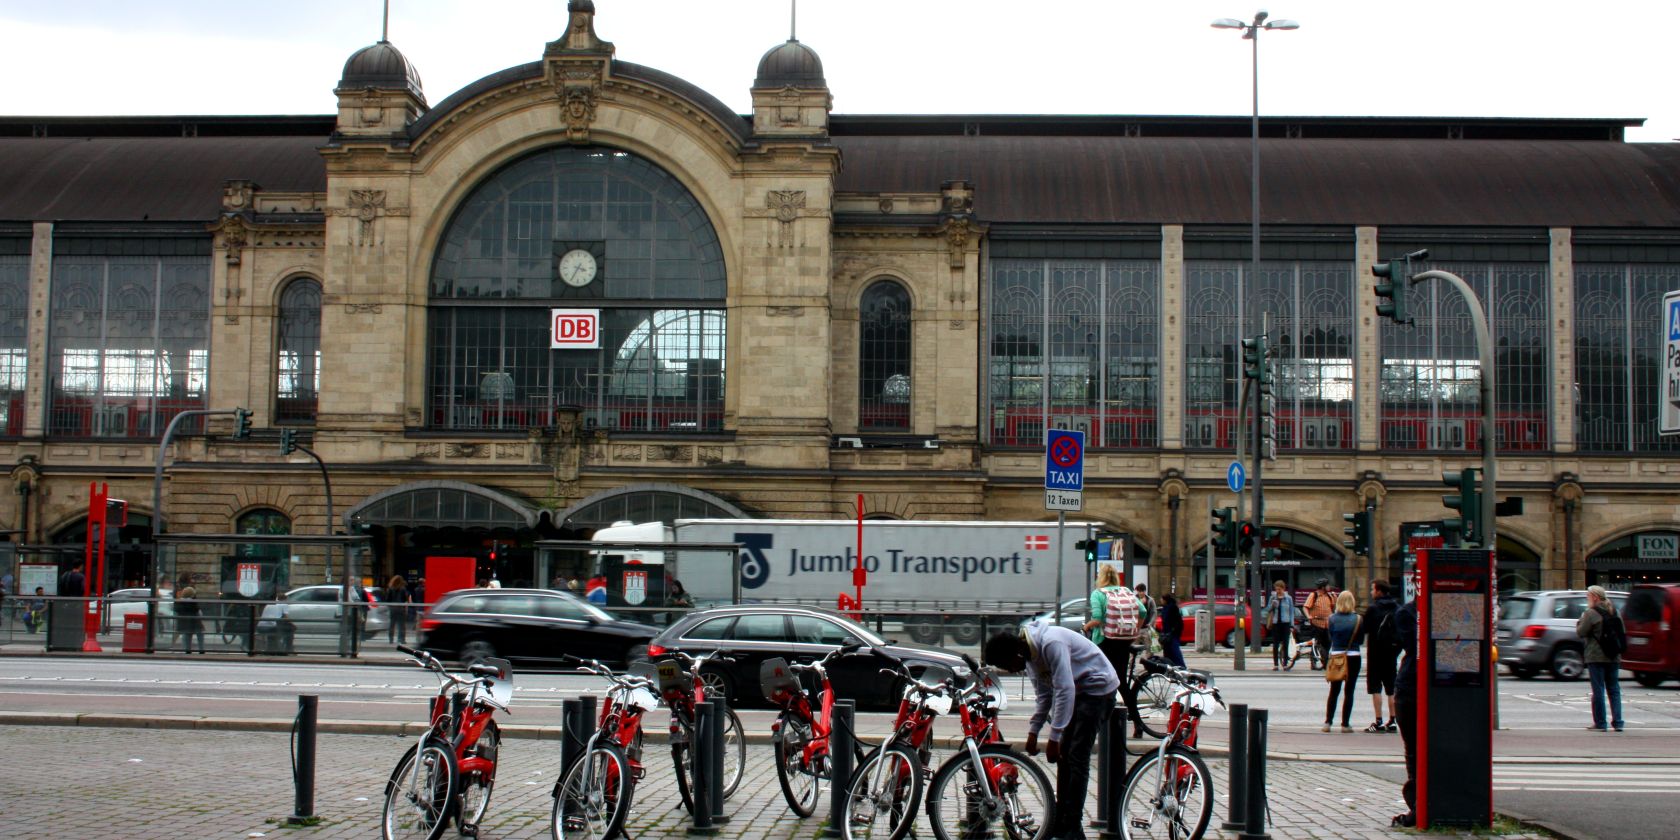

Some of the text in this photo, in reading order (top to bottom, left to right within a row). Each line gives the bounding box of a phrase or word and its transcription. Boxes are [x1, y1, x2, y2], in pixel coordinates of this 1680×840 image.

[560, 318, 591, 339] DB
[1049, 471, 1079, 485] TAXI
[1047, 494, 1079, 506] 12 Taxen
[1643, 537, 1675, 550] FON
[787, 546, 1022, 582] Jumbo Transport
